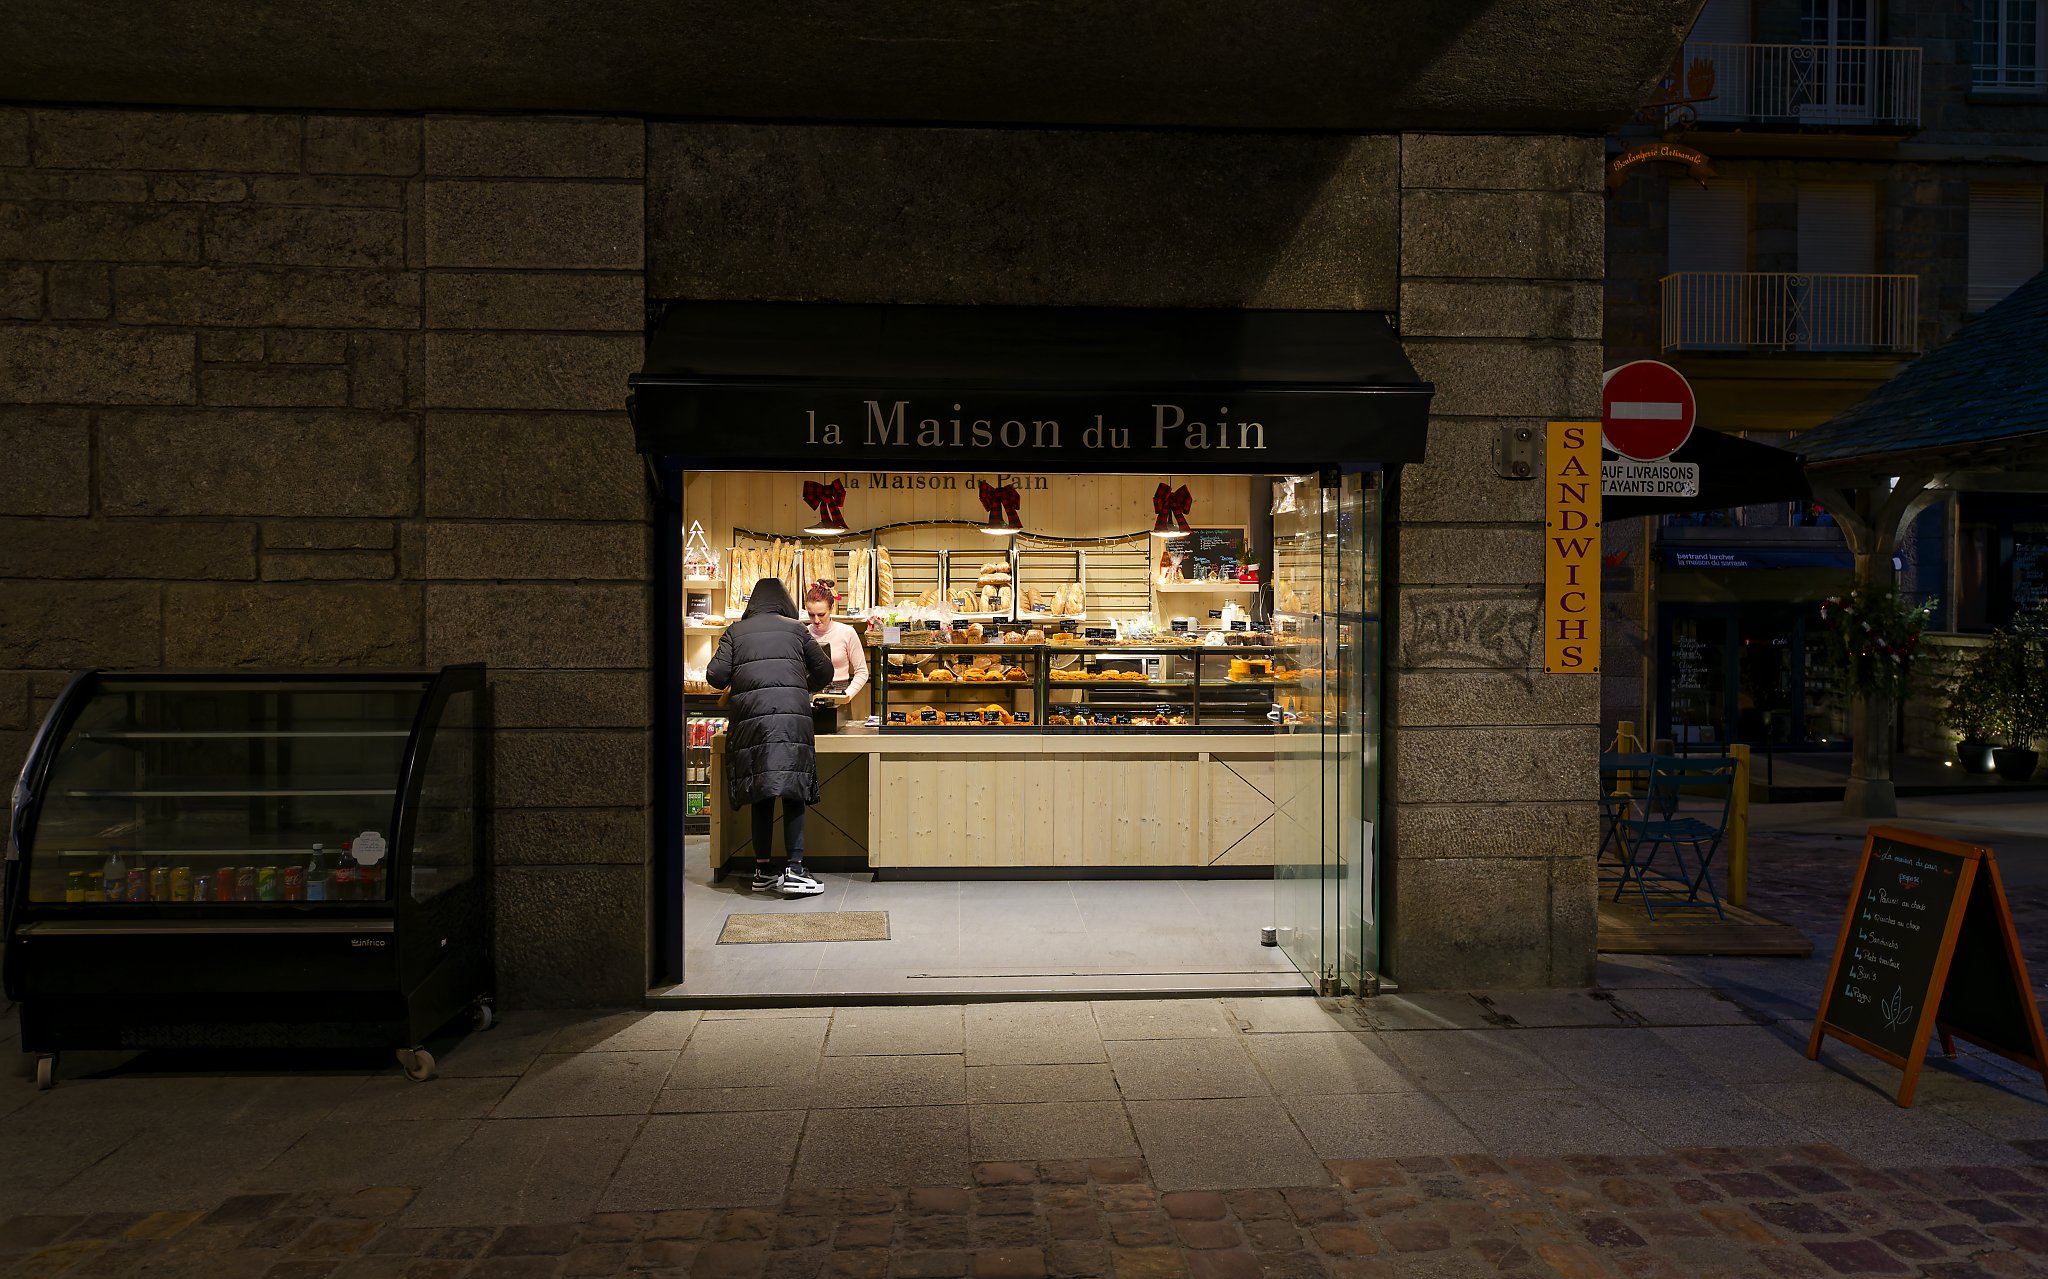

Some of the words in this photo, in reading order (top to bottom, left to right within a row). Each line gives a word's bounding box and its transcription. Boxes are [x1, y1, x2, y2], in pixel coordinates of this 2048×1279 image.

[805, 409, 844, 446] la
[863, 399, 1063, 448] Maison
[1082, 414, 1131, 449] du
[1150, 403, 1267, 450] Pain
[1602, 465, 1623, 479] AUF
[1626, 466, 1694, 480] LIVRAISONS
[843, 472, 860, 489] la
[868, 472, 957, 490] Maison
[965, 473, 987, 490] d
[997, 473, 1049, 490] Pain
[1609, 480, 1654, 493] AYANTS
[1657, 481, 1694, 493] DRO
[1552, 427, 1596, 668] SANDWICHS
[1676, 552, 1708, 561] bertrand
[1708, 553, 1735, 561] larcher
[1711, 559, 1721, 567] du
[359, 938, 386, 947] infrico
